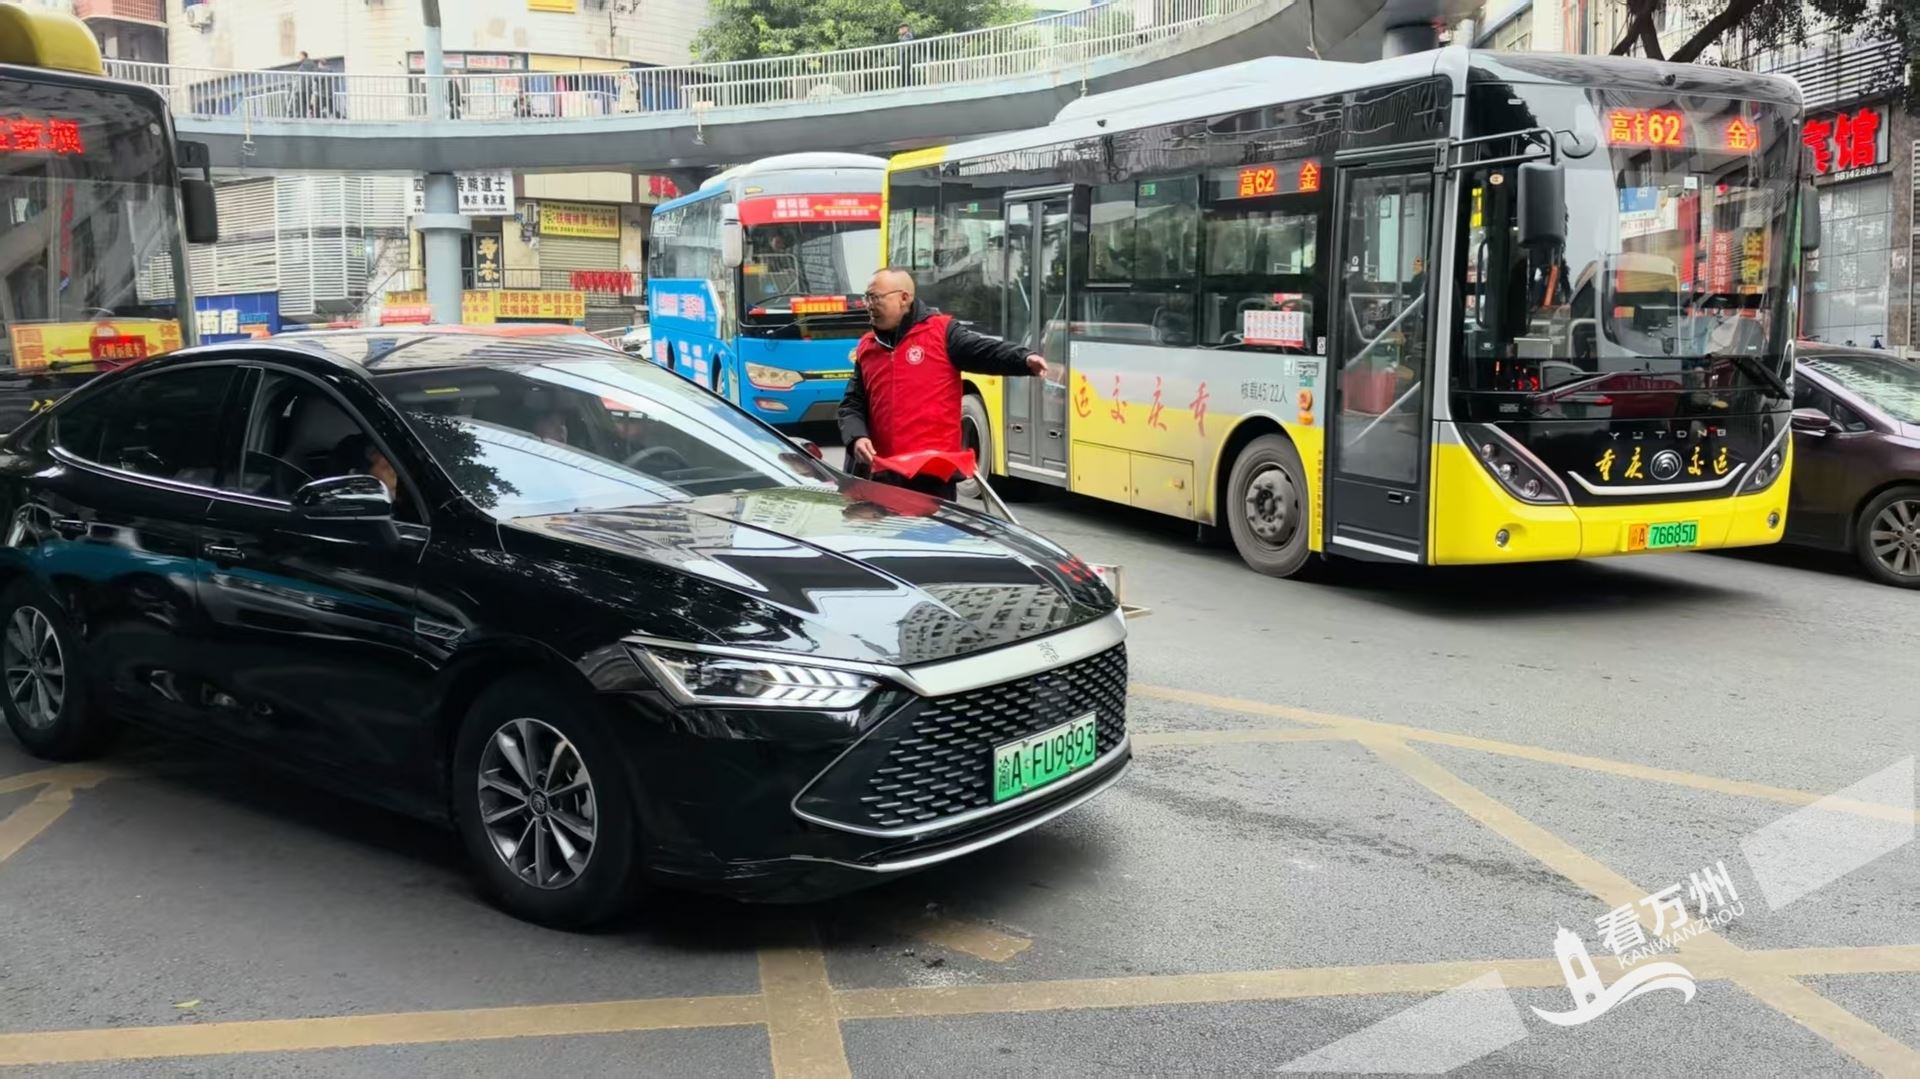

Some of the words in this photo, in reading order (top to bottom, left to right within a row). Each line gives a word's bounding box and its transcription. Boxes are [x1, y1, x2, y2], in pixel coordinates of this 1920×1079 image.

[1240, 168, 1275, 196] 高62
[1300, 163, 1318, 191] 金
[1651, 524, 1697, 546] 76685D
